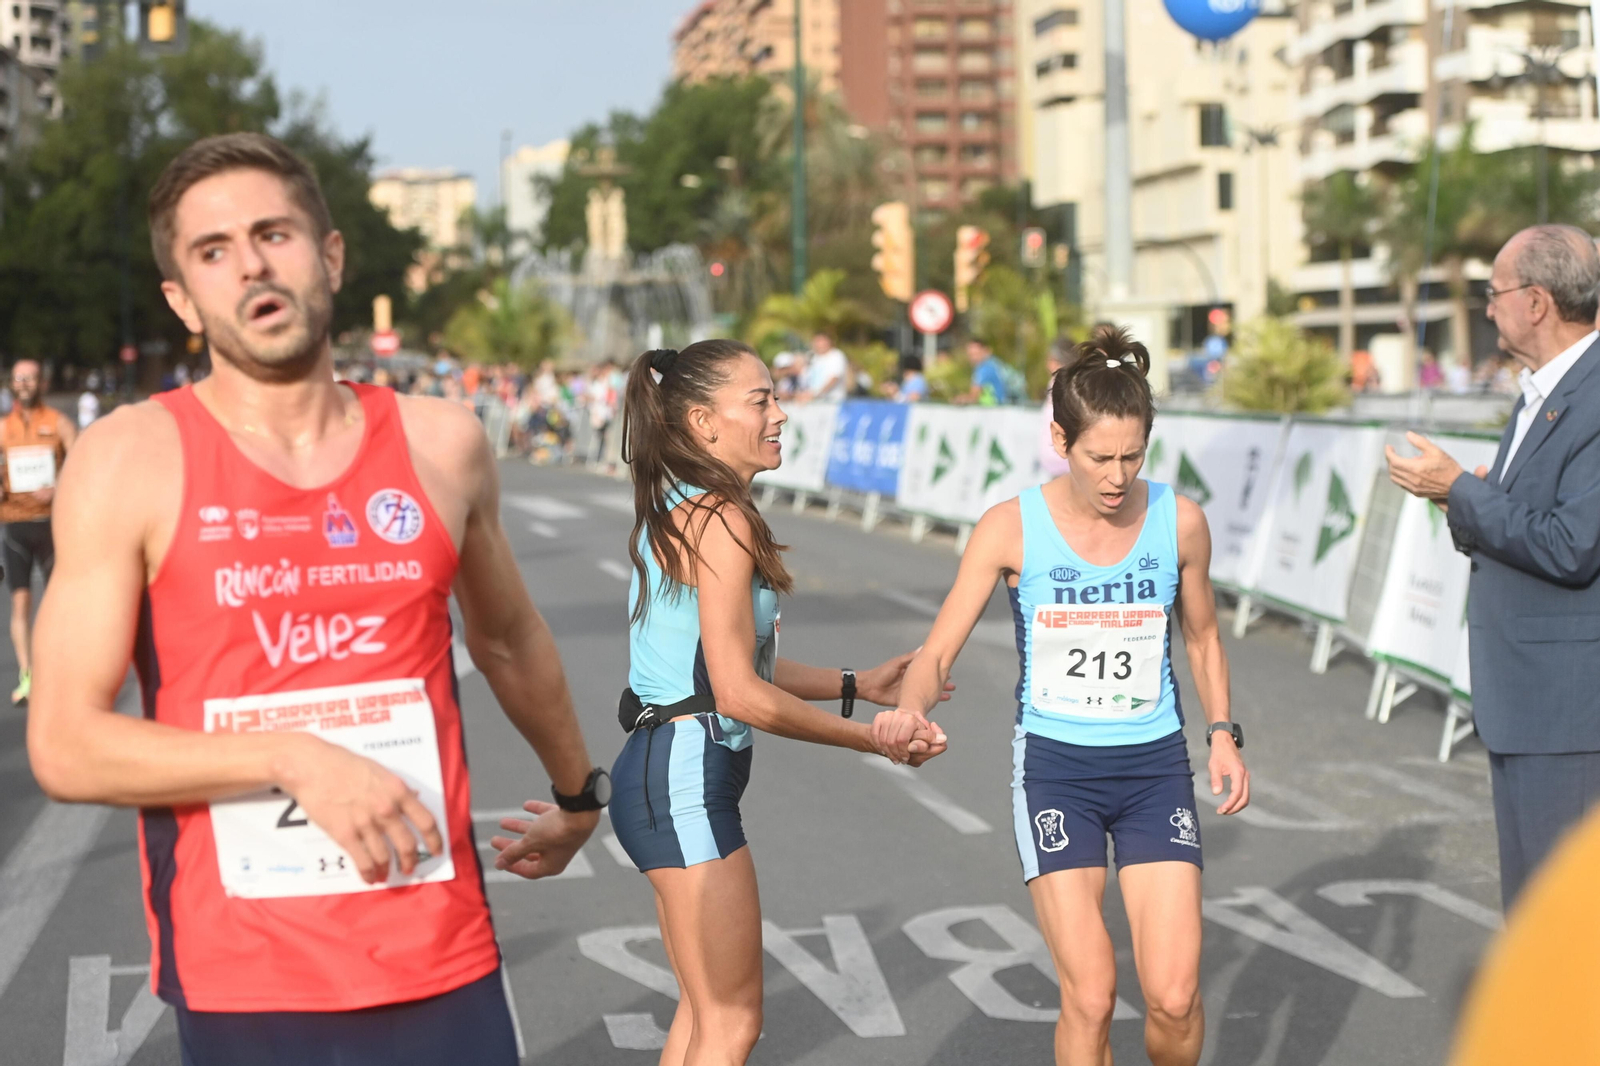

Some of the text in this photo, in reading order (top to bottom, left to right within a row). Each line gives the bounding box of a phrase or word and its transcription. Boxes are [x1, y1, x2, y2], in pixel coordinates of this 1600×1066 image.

[307, 560, 423, 586] FERTILIDAD
[1050, 568, 1081, 581] TROPS
[1053, 573, 1158, 604] nerja
[1037, 610, 1164, 628] 42 CARRERA URBANA
[252, 610, 388, 669] Vélez
[1123, 634, 1157, 642] FEDERADO
[1066, 648, 1132, 680] 213
